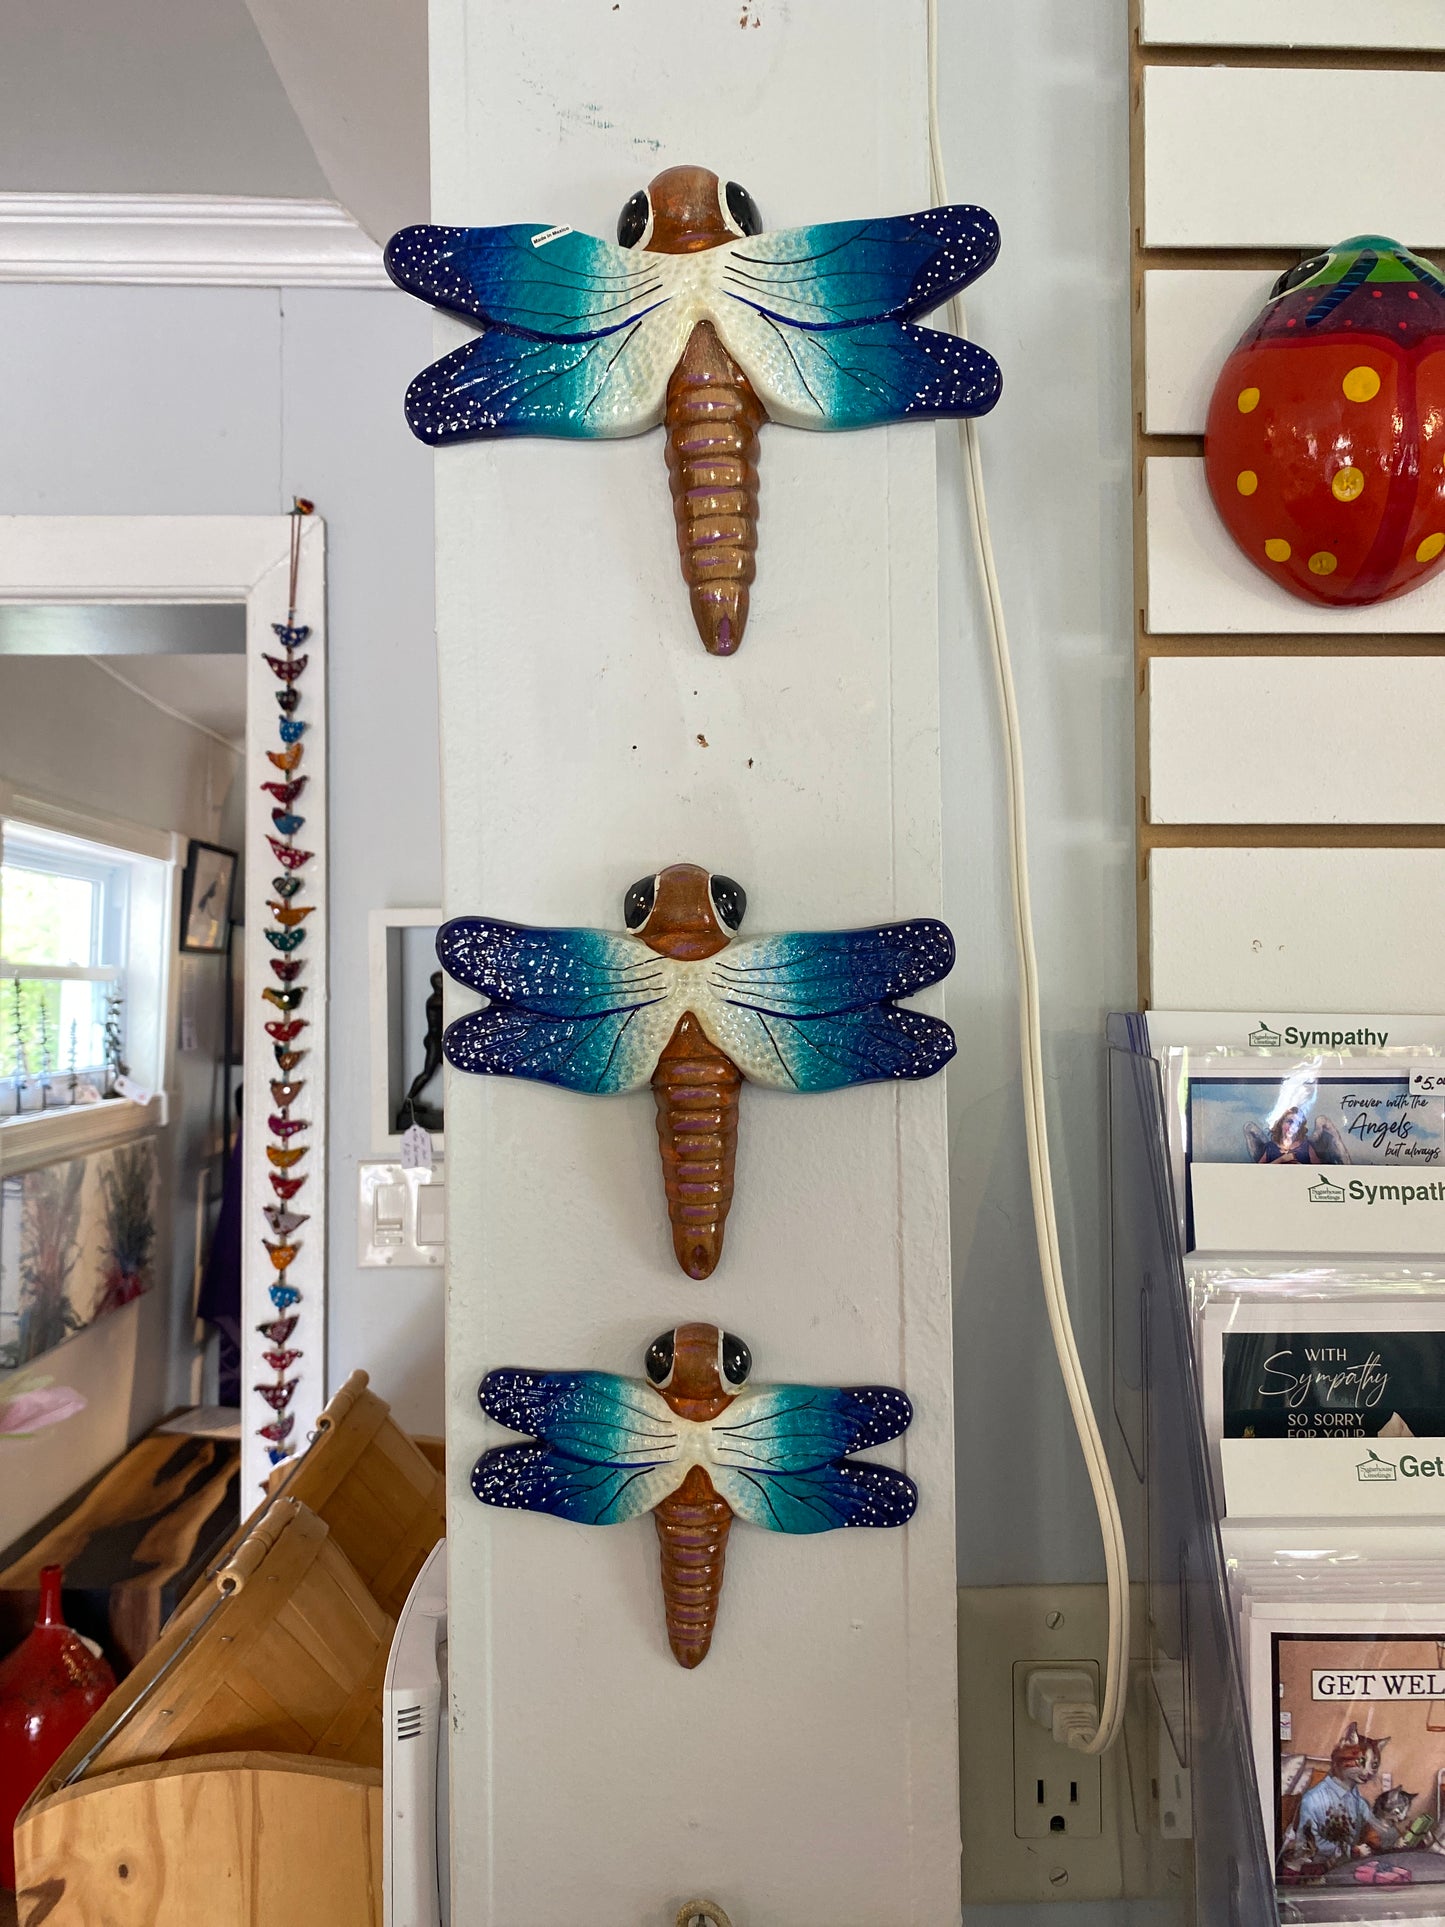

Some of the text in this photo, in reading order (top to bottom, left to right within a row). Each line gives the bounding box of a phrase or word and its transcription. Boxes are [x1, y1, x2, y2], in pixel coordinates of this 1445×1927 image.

[533, 236, 547, 244] Made
[552, 226, 570, 235] Mexico
[1285, 1026, 1389, 1049] Sympathy
[1340, 1095, 1383, 1110] Forever
[1386, 1094, 1409, 1109] with
[1348, 1112, 1413, 1148] Angels
[1385, 1141, 1441, 1162] but always
[1304, 1348, 1347, 1361] WITH
[1258, 1351, 1390, 1408] Sympathy
[1287, 1413, 1365, 1426] SO SORRY
[1287, 1429, 1366, 1438] FOR YOUR
[1399, 1455, 1445, 1478] Get
[1318, 1674, 1445, 1695] GET WEL
